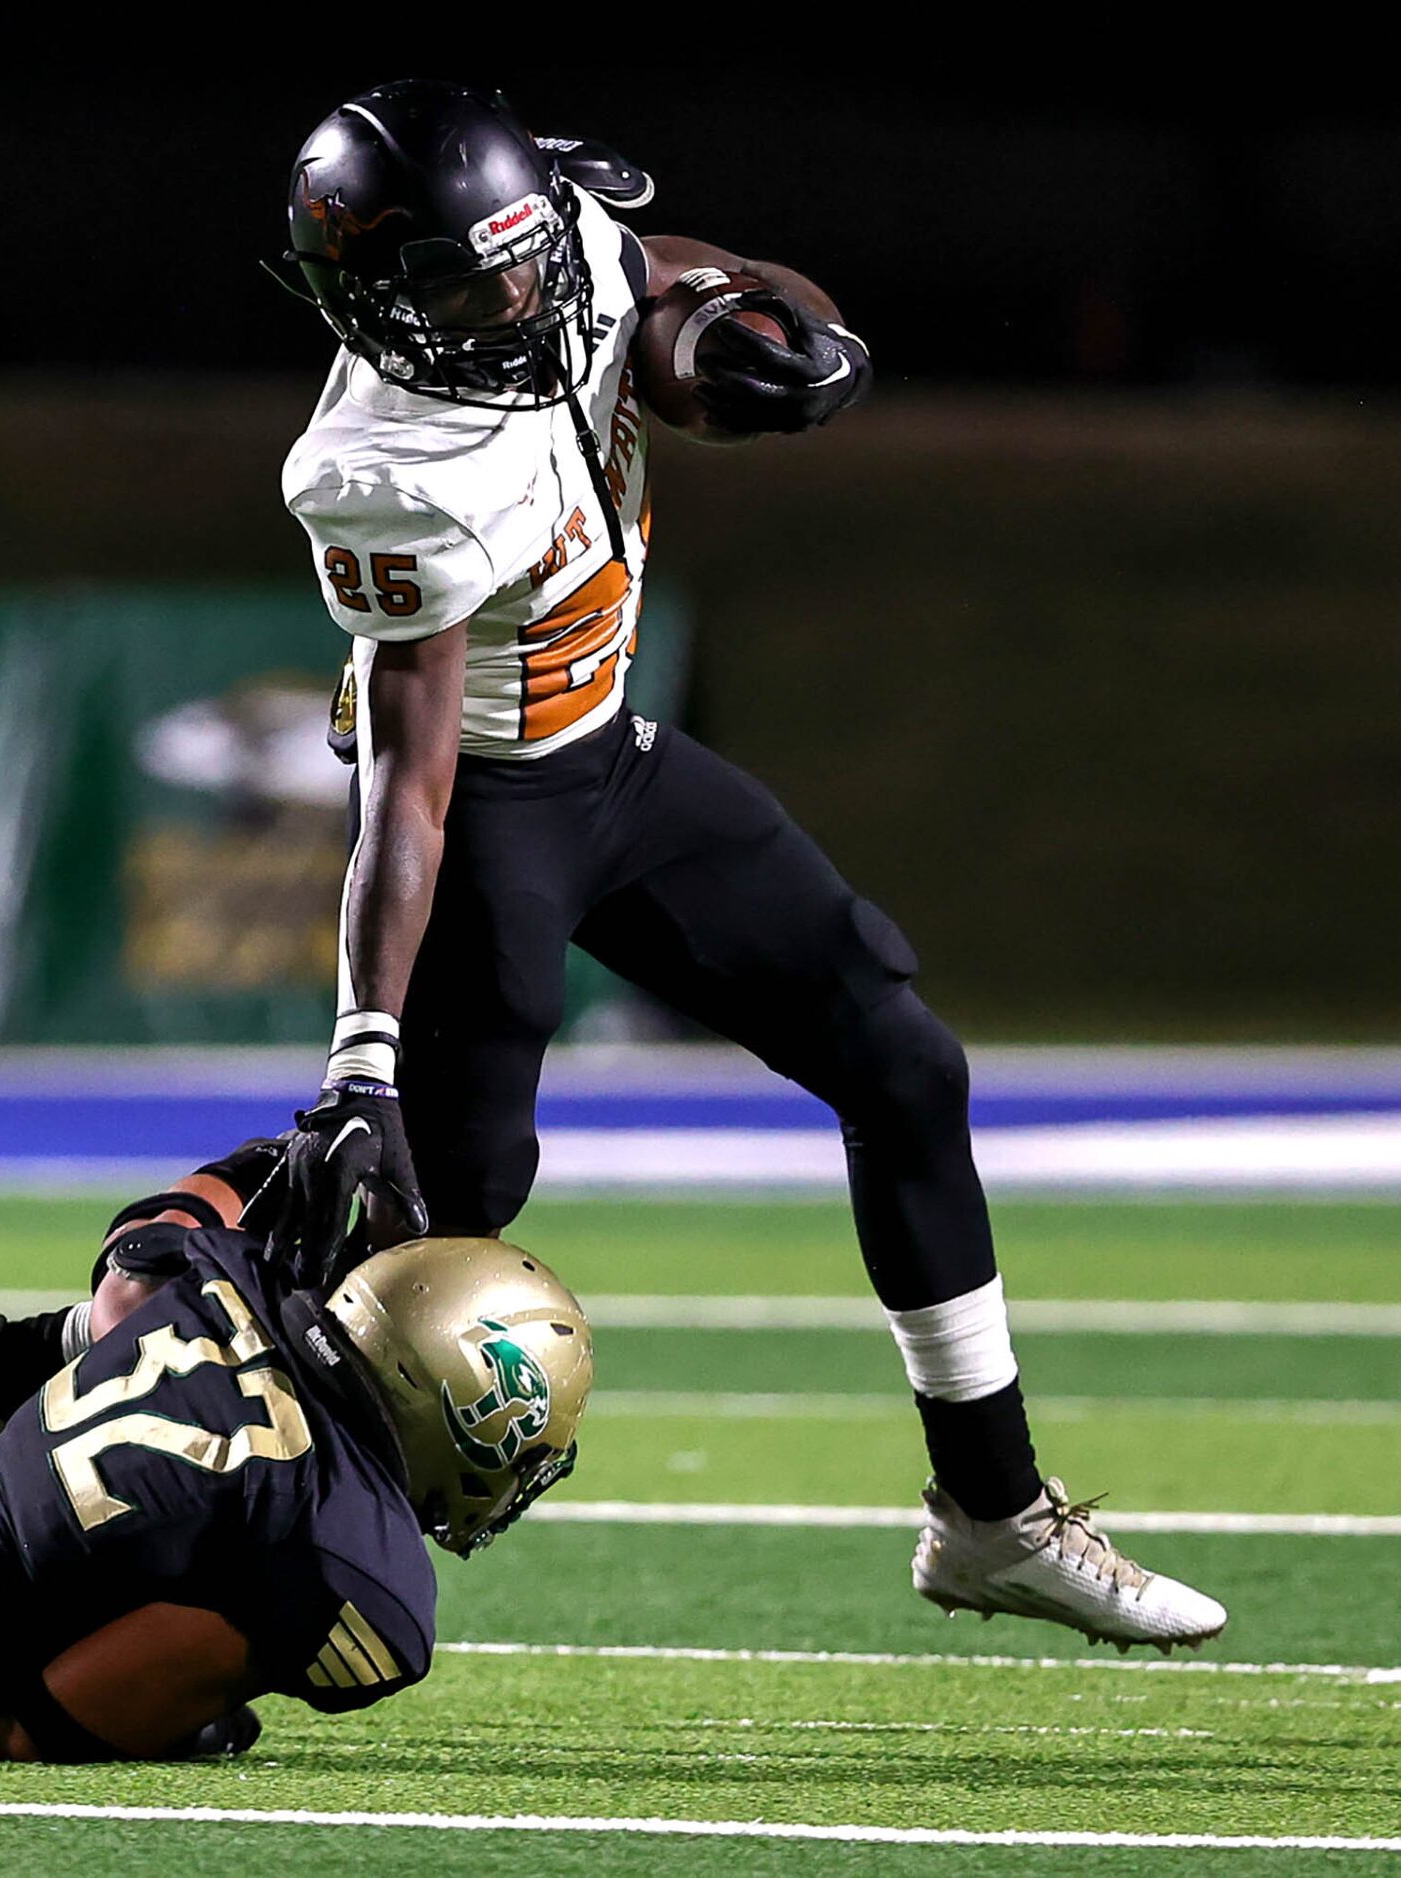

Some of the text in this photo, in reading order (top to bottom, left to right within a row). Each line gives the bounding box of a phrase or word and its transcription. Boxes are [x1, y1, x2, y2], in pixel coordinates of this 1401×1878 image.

[487, 203, 533, 236] Riddell
[324, 545, 422, 617] 25
[517, 556, 647, 742] 2
[305, 1325, 341, 1366] McDavid
[42, 1280, 314, 1531] 32
